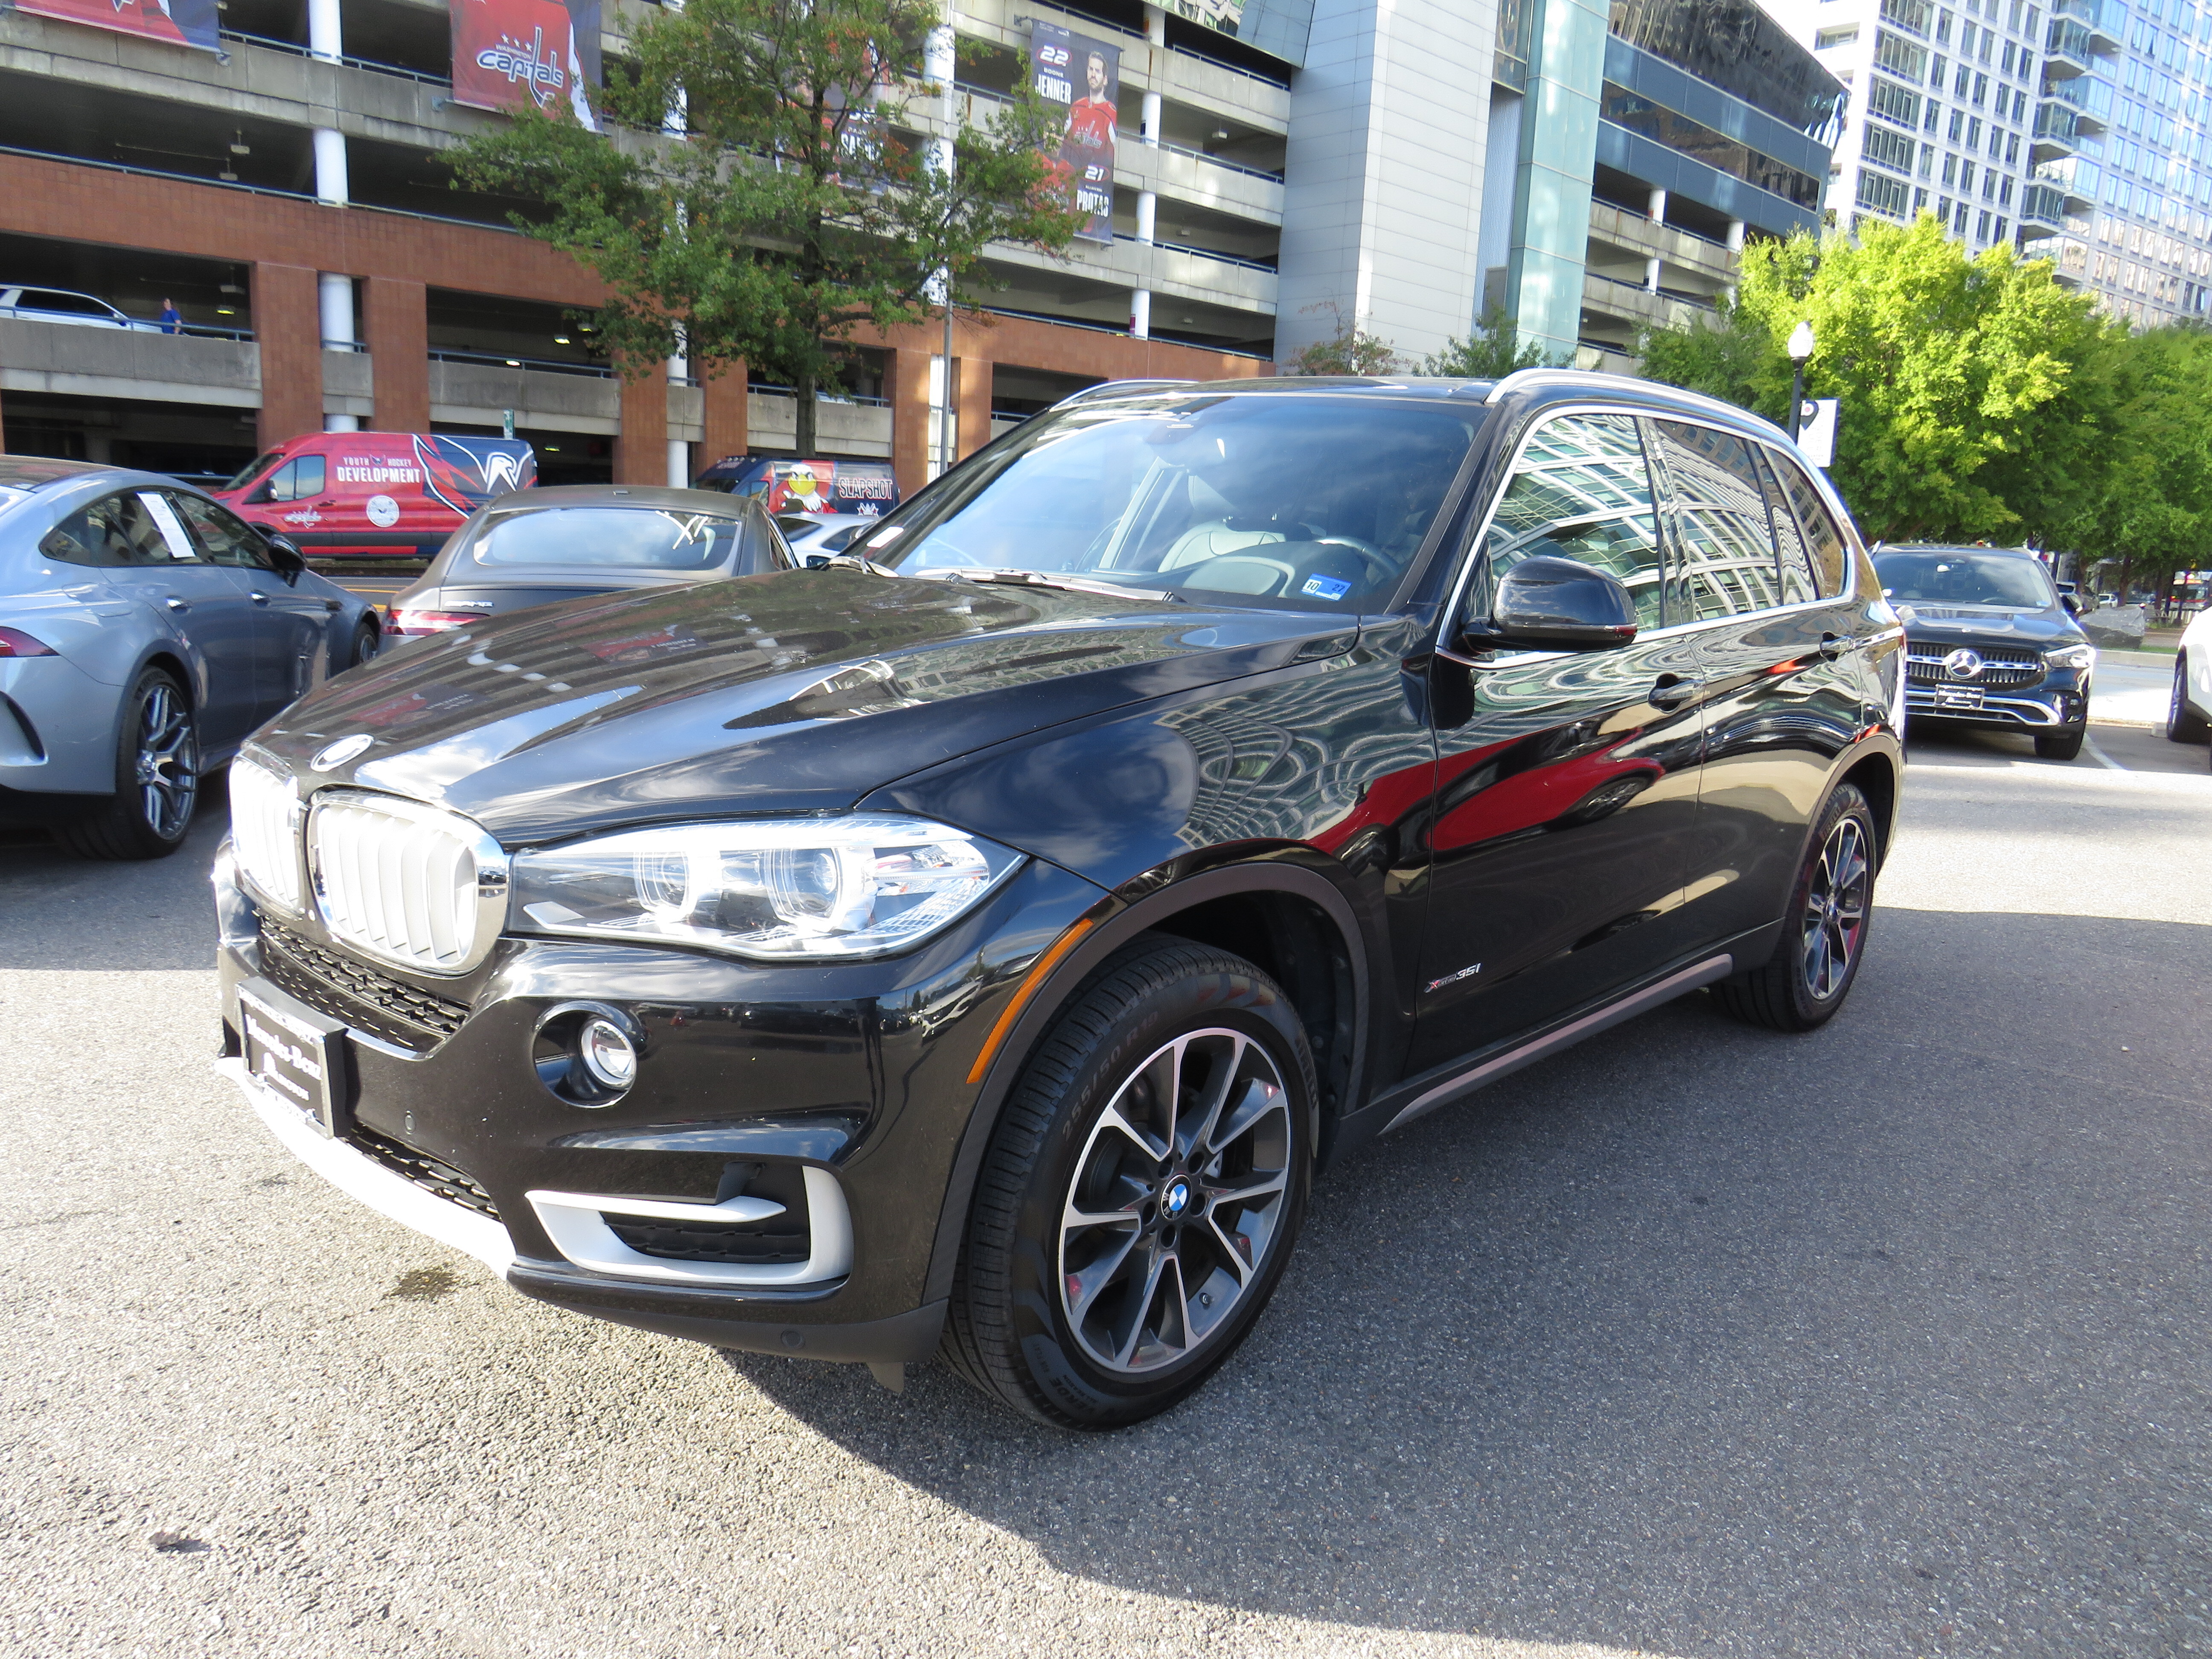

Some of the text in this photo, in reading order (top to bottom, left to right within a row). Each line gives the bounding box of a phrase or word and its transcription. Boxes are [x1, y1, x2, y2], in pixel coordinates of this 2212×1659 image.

[1040, 44, 1069, 67] 22
[1043, 67, 1064, 79] BOONE
[1035, 73, 1072, 105] JENNER
[1084, 165, 1104, 181] 21
[343, 457, 412, 467] YOUTH HOCKEY
[336, 466, 420, 483] DEVELOPMENT
[838, 477, 893, 500] SLAPSHOT
[1307, 581, 1320, 591] 10
